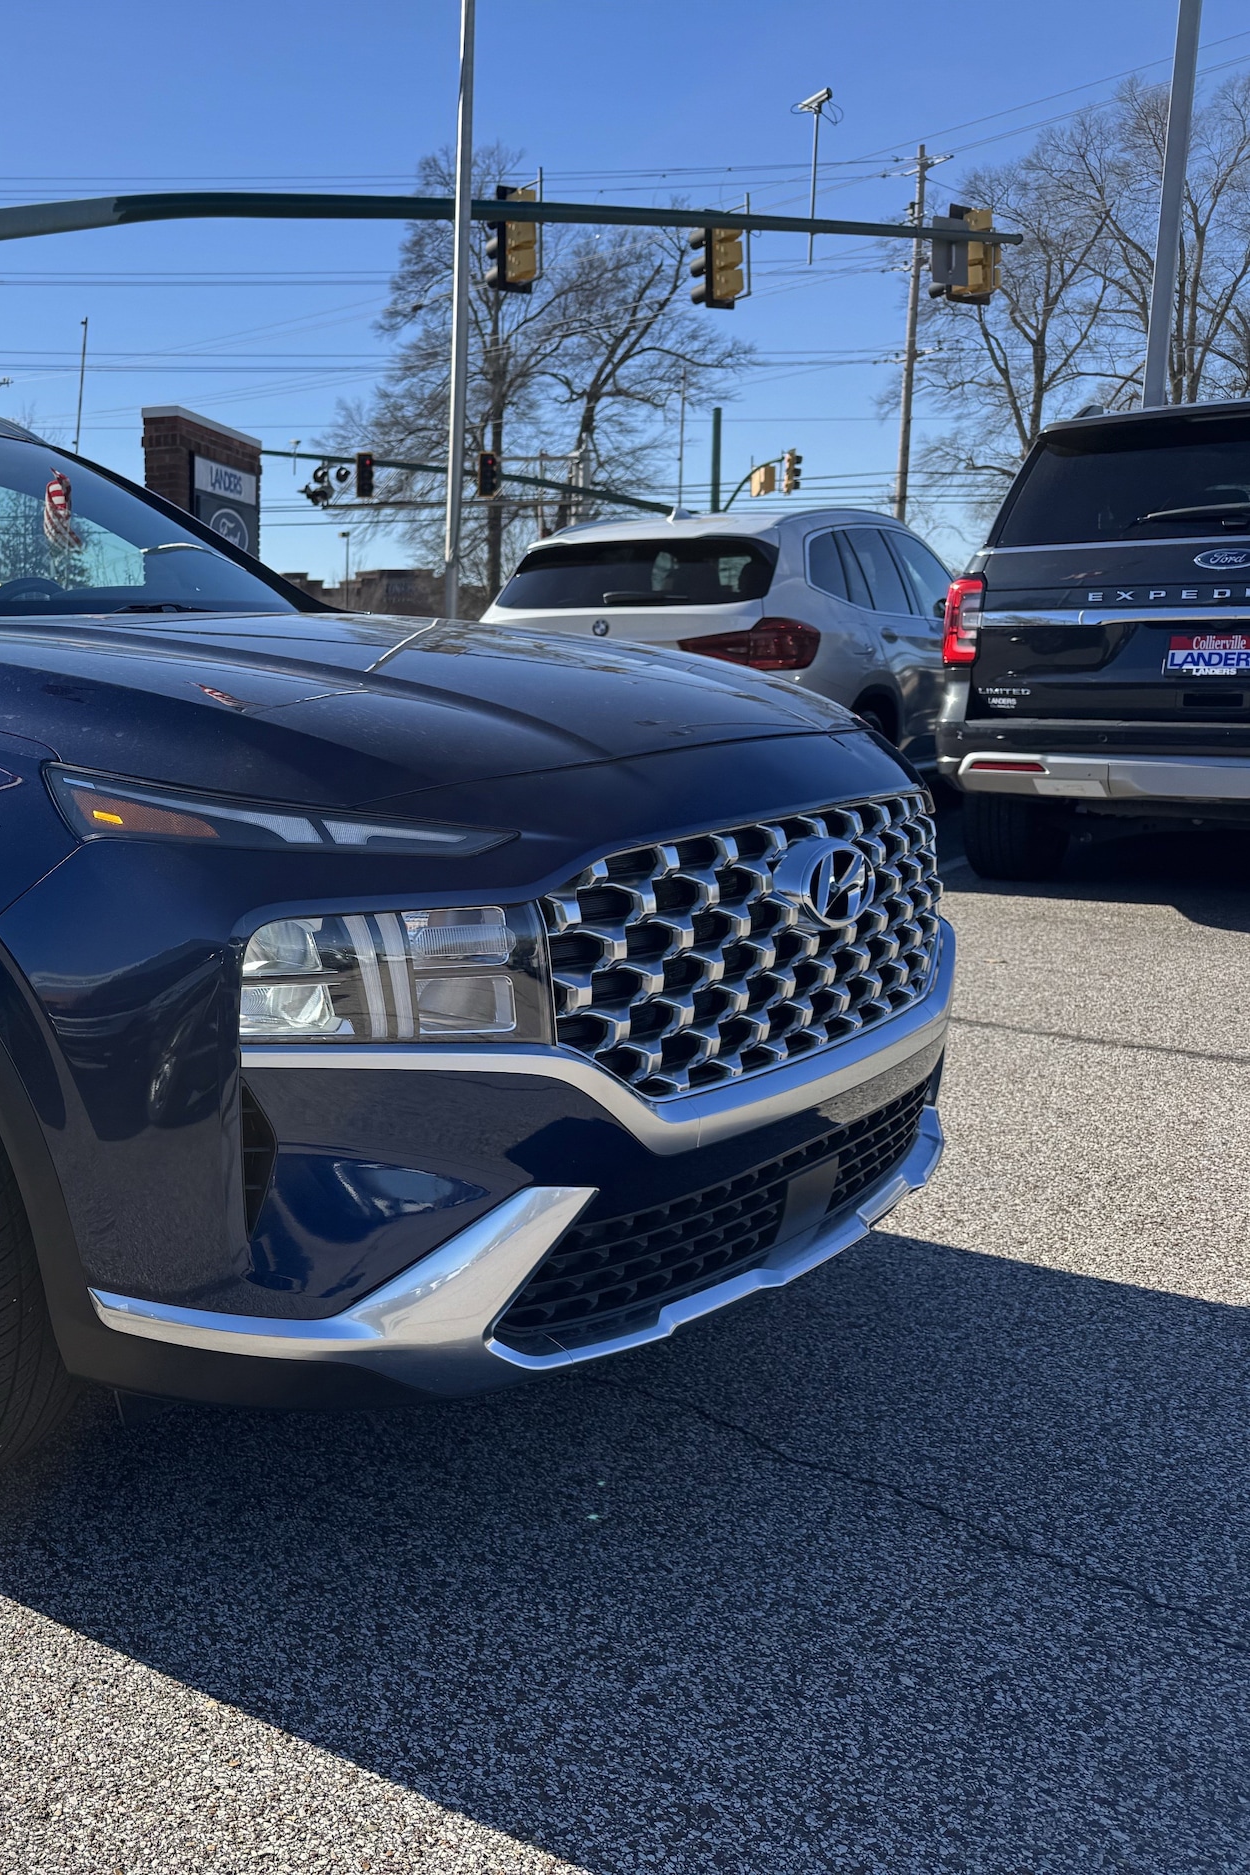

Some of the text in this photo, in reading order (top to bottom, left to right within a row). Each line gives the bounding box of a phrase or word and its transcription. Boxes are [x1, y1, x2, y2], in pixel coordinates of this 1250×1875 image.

[209, 465, 243, 496] LANDERS
[1209, 551, 1247, 564] Ford
[1192, 635, 1247, 650] Collierville
[1192, 667, 1237, 676] LANDERS
[978, 687, 1031, 696] LIMITED
